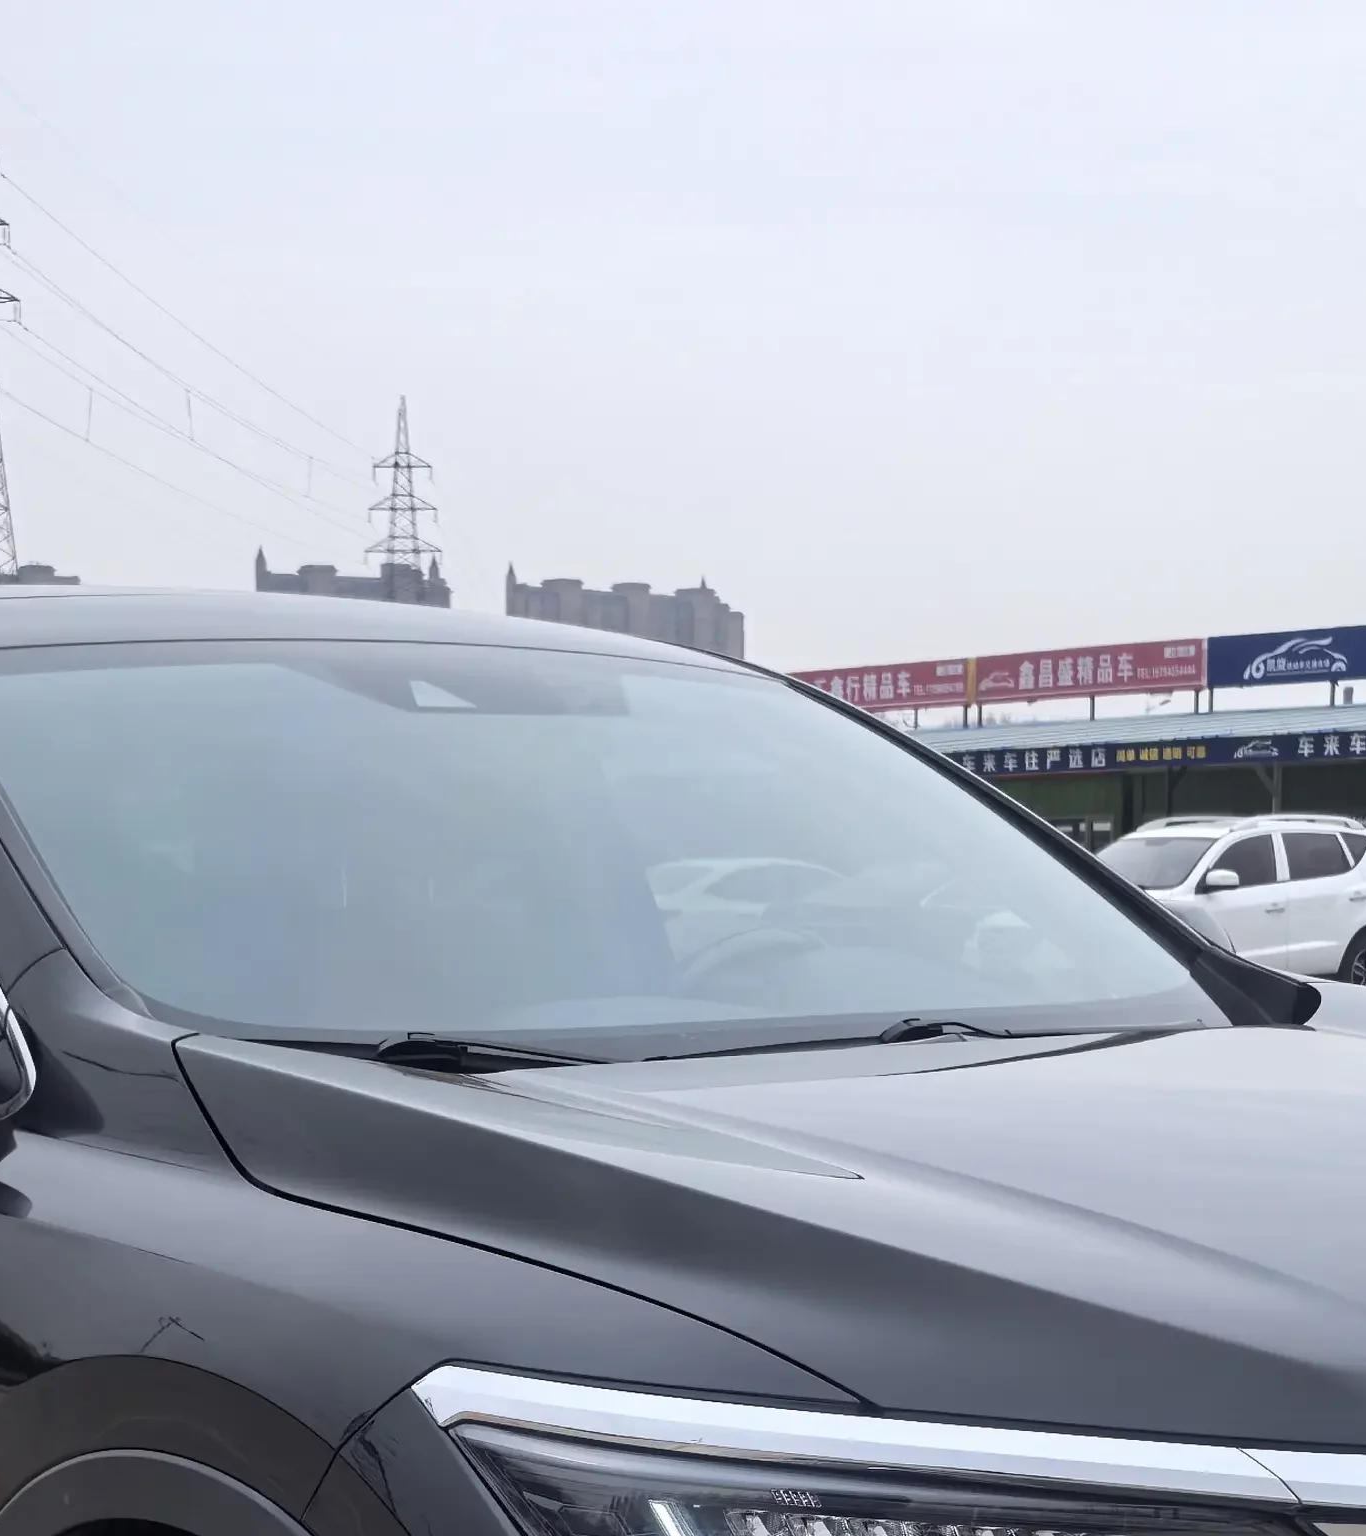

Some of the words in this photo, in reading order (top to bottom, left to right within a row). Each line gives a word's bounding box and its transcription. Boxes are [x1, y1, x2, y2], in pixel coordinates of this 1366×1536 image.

[1018, 653, 1133, 690] 鑫昌盛精品车
